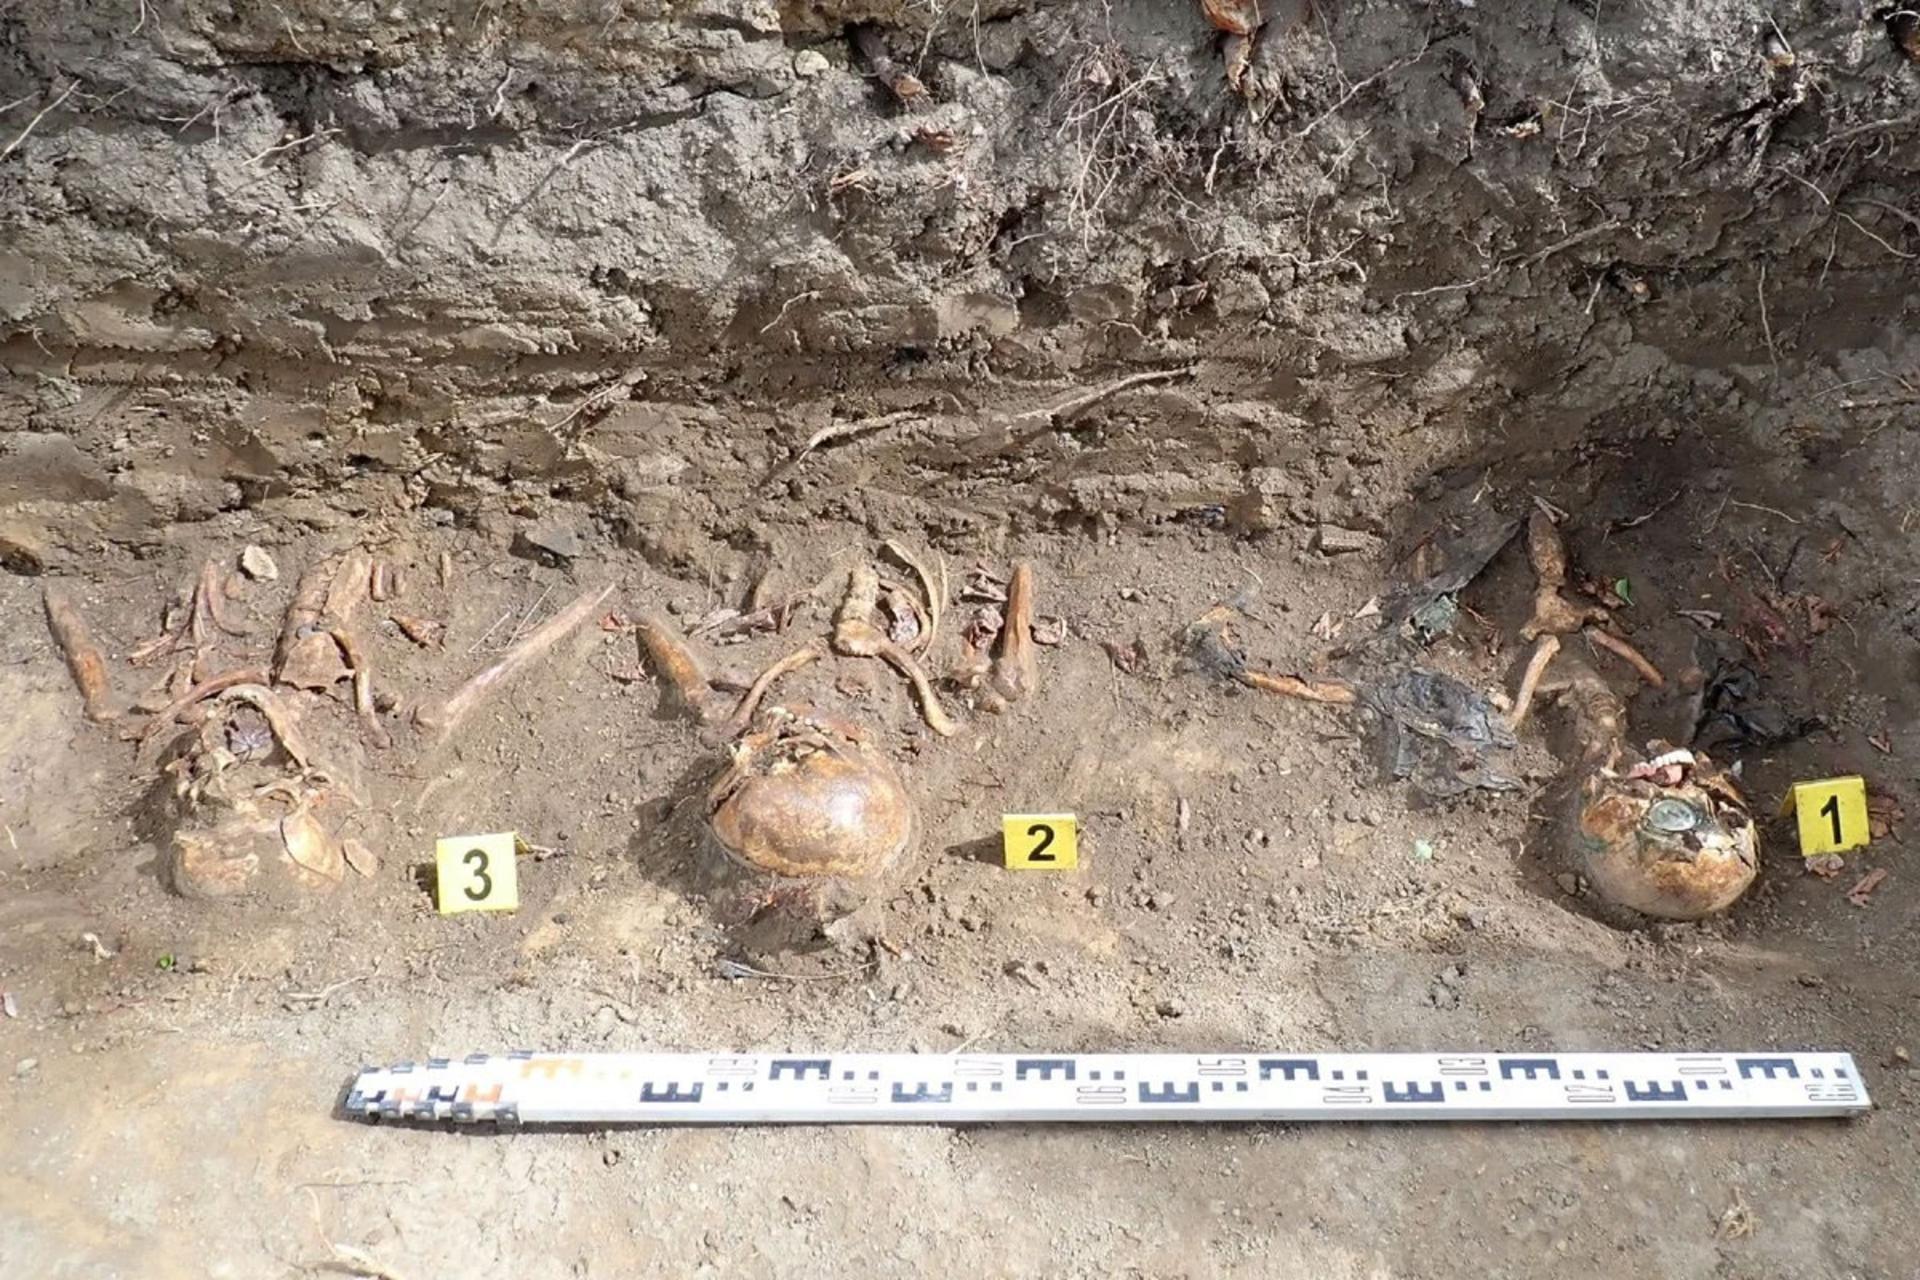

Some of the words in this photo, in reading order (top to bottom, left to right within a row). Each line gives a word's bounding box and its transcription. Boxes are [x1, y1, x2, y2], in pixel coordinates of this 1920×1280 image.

[1820, 794, 1843, 845] 1
[1027, 823, 1056, 861] 2
[462, 848, 492, 901] 3
[1197, 1058, 1247, 1075] 05
[1437, 1058, 1488, 1075] 03
[1675, 1057, 1728, 1074] 01
[1076, 1086, 1127, 1104] 06
[1321, 1086, 1373, 1103] 04
[1564, 1085, 1616, 1103] 02
